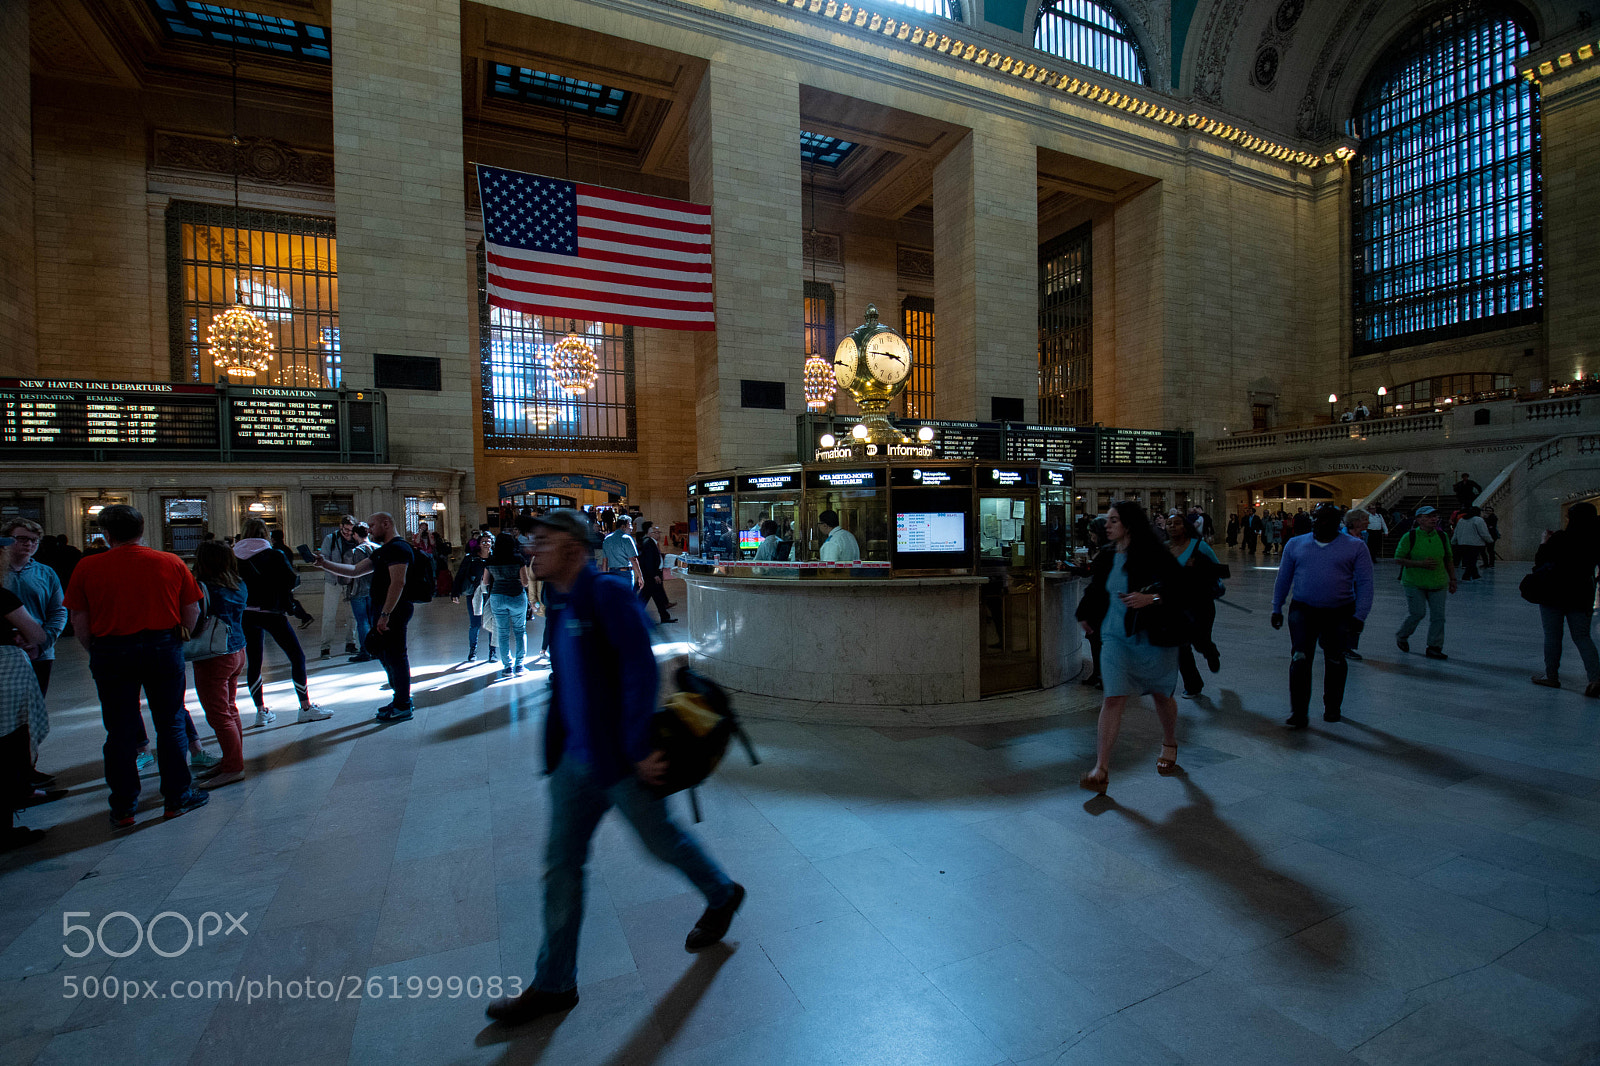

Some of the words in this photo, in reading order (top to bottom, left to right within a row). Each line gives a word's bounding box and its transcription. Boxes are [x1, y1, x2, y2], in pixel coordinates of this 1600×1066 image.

[112, 383, 172, 392] DEPARTURES
[252, 388, 316, 397] INFORMATION
[888, 444, 932, 456] Information
